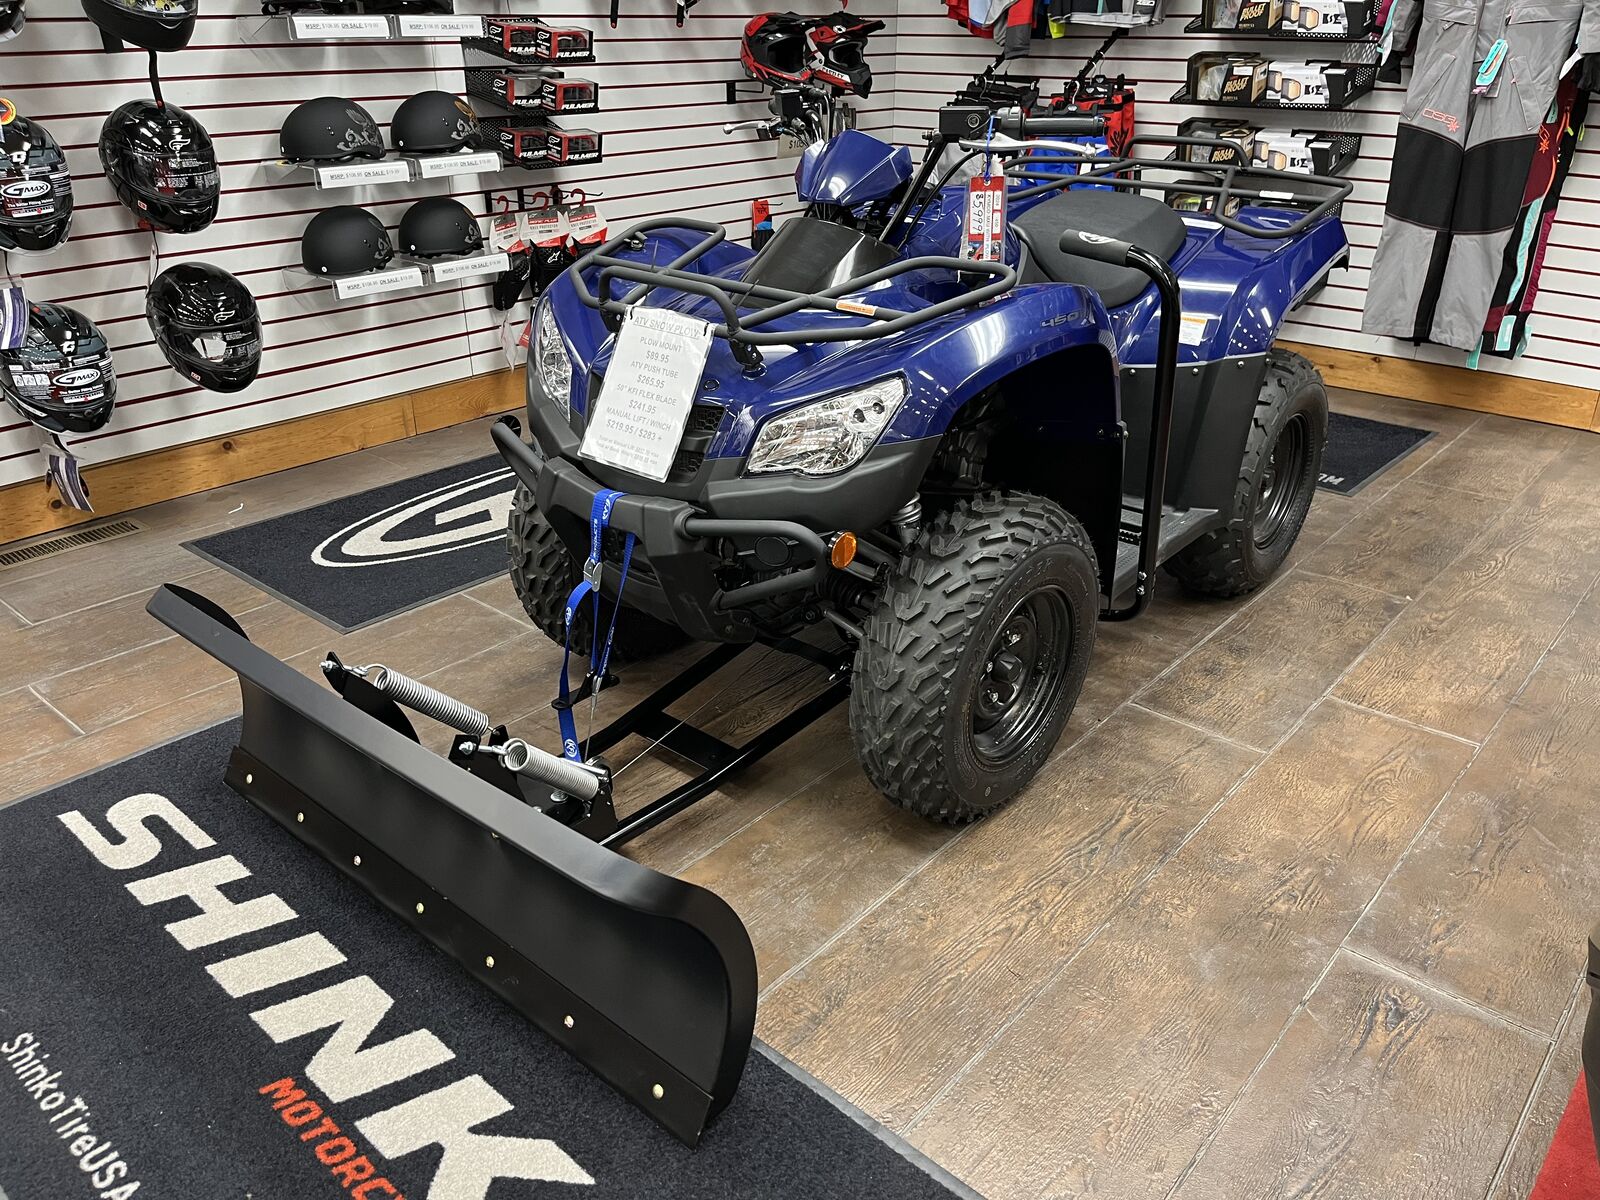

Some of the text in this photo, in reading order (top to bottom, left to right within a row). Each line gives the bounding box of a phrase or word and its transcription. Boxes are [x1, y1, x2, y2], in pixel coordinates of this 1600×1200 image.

[561, 102, 595, 110] FULMER
[566, 152, 599, 160] FULMER
[3, 181, 50, 198] GMAX
[634, 316, 700, 338] ATV SNOW PLOW
[1041, 312, 1080, 327] 450
[640, 336, 682, 352] PLOW MOUNT
[646, 350, 670, 363] $89.95
[631, 360, 679, 378] ATV PUSH TUBE
[53, 369, 101, 387] GMAX
[637, 374, 665, 389] $265.95
[639, 389, 655, 400] FLEX
[655, 394, 677, 407] BLADE
[628, 399, 657, 414] $241.95
[606, 406, 631, 421] MANUAL
[632, 414, 647, 424] LIFT
[650, 419, 672, 432] WINCH
[606, 418, 634, 434] $219.95
[638, 428, 656, 441] $283
